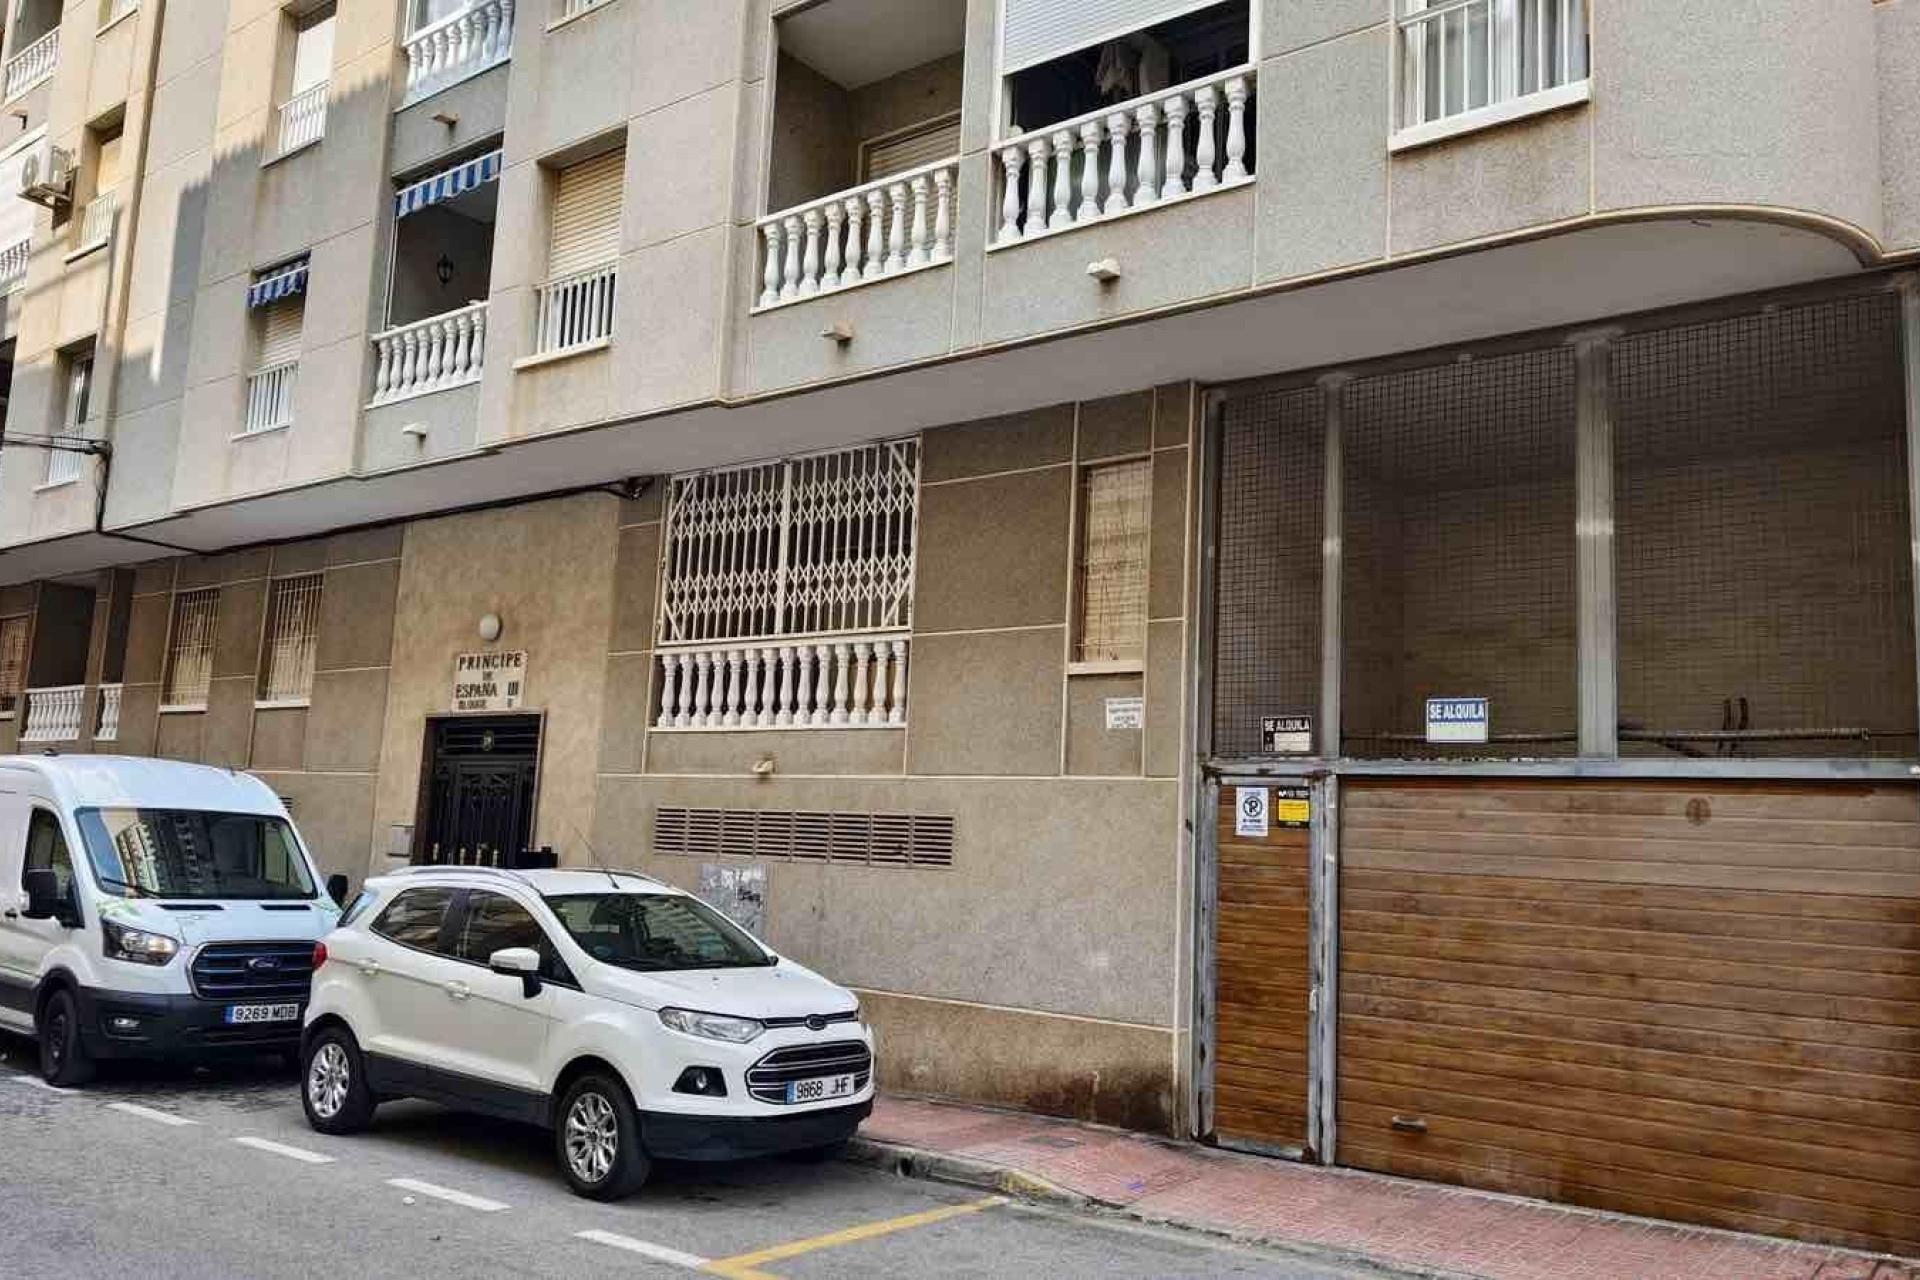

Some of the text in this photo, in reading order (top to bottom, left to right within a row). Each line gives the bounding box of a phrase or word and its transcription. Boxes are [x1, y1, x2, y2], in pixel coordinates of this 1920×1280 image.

[458, 653, 522, 671] PRINCIPE
[1429, 703, 1485, 719] SE ALQUILA
[1264, 718, 1310, 731] SE ALQUILA
[235, 1006, 269, 1021] 9269
